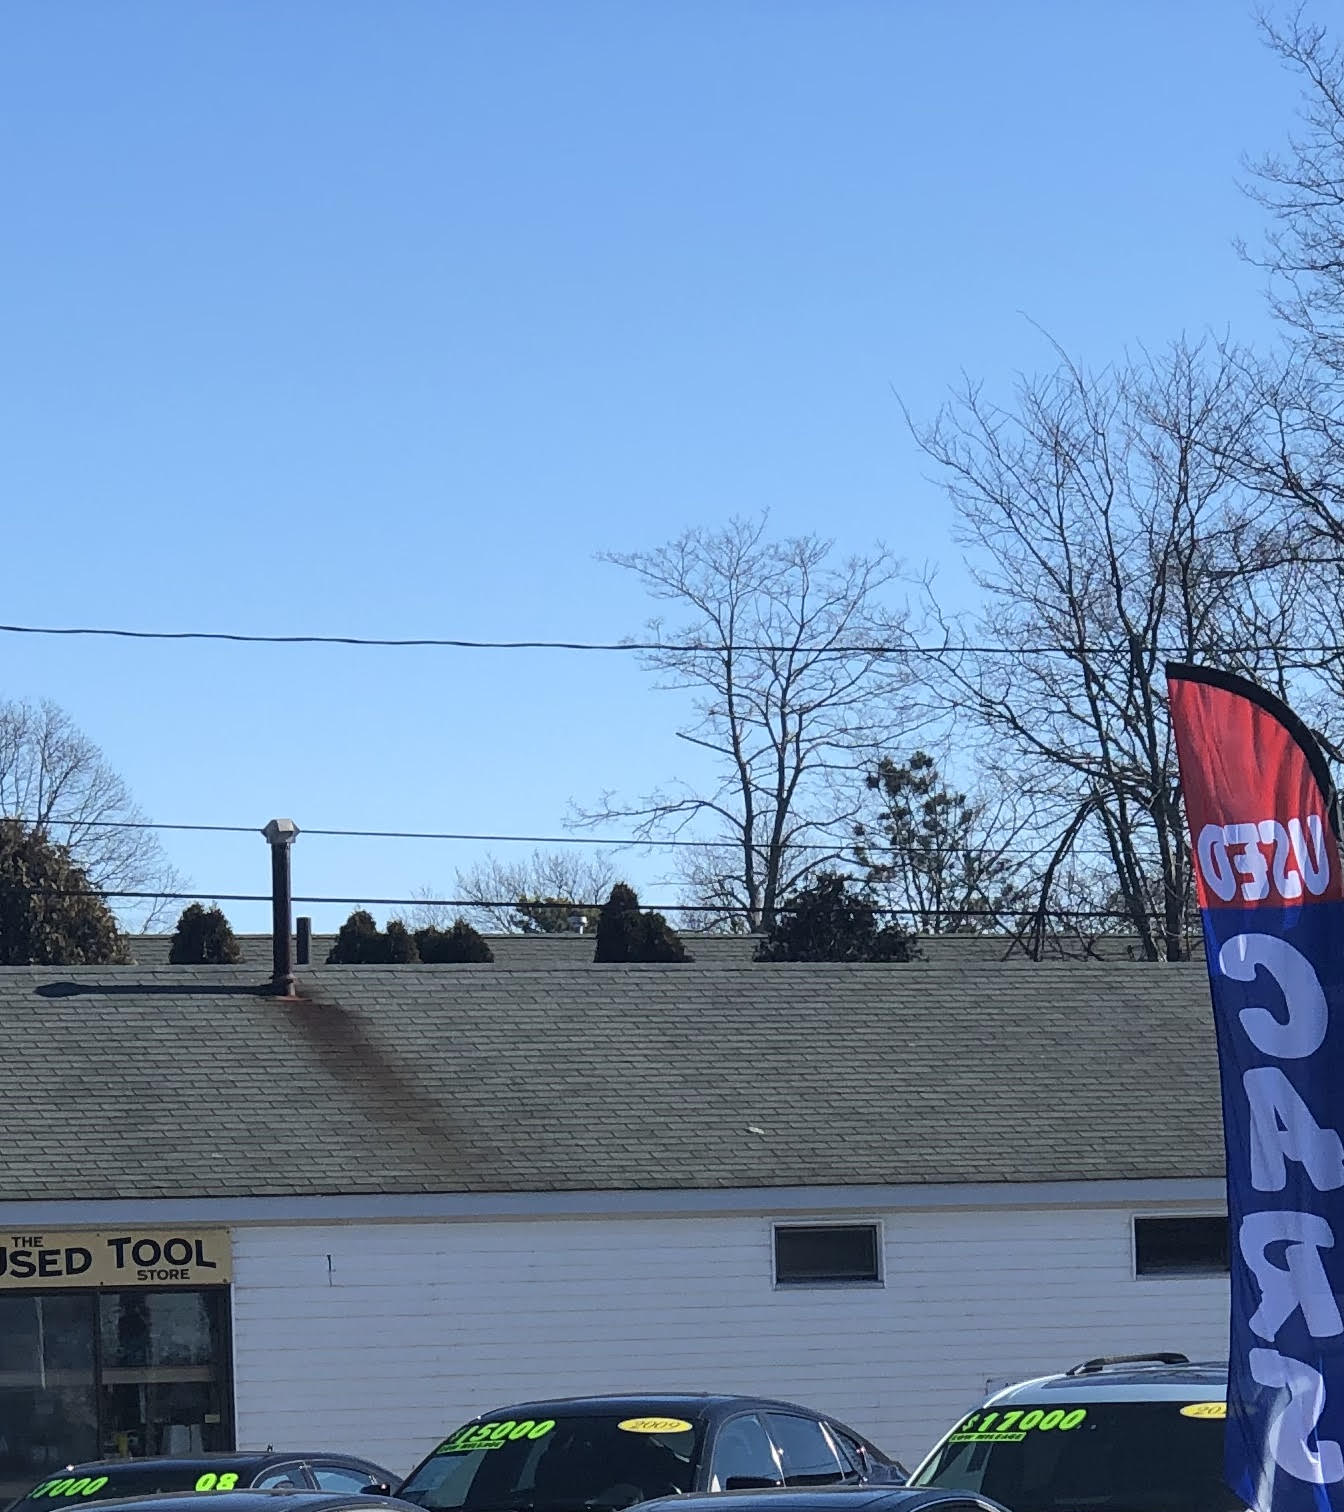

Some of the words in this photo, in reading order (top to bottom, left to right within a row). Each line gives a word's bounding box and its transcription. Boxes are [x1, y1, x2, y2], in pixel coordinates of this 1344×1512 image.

[11, 1236, 44, 1248] THE
[107, 1236, 217, 1269] TOOL
[137, 1268, 190, 1281] STORE
[962, 1409, 1087, 1431] $17000
[195, 1472, 239, 1491] 08
